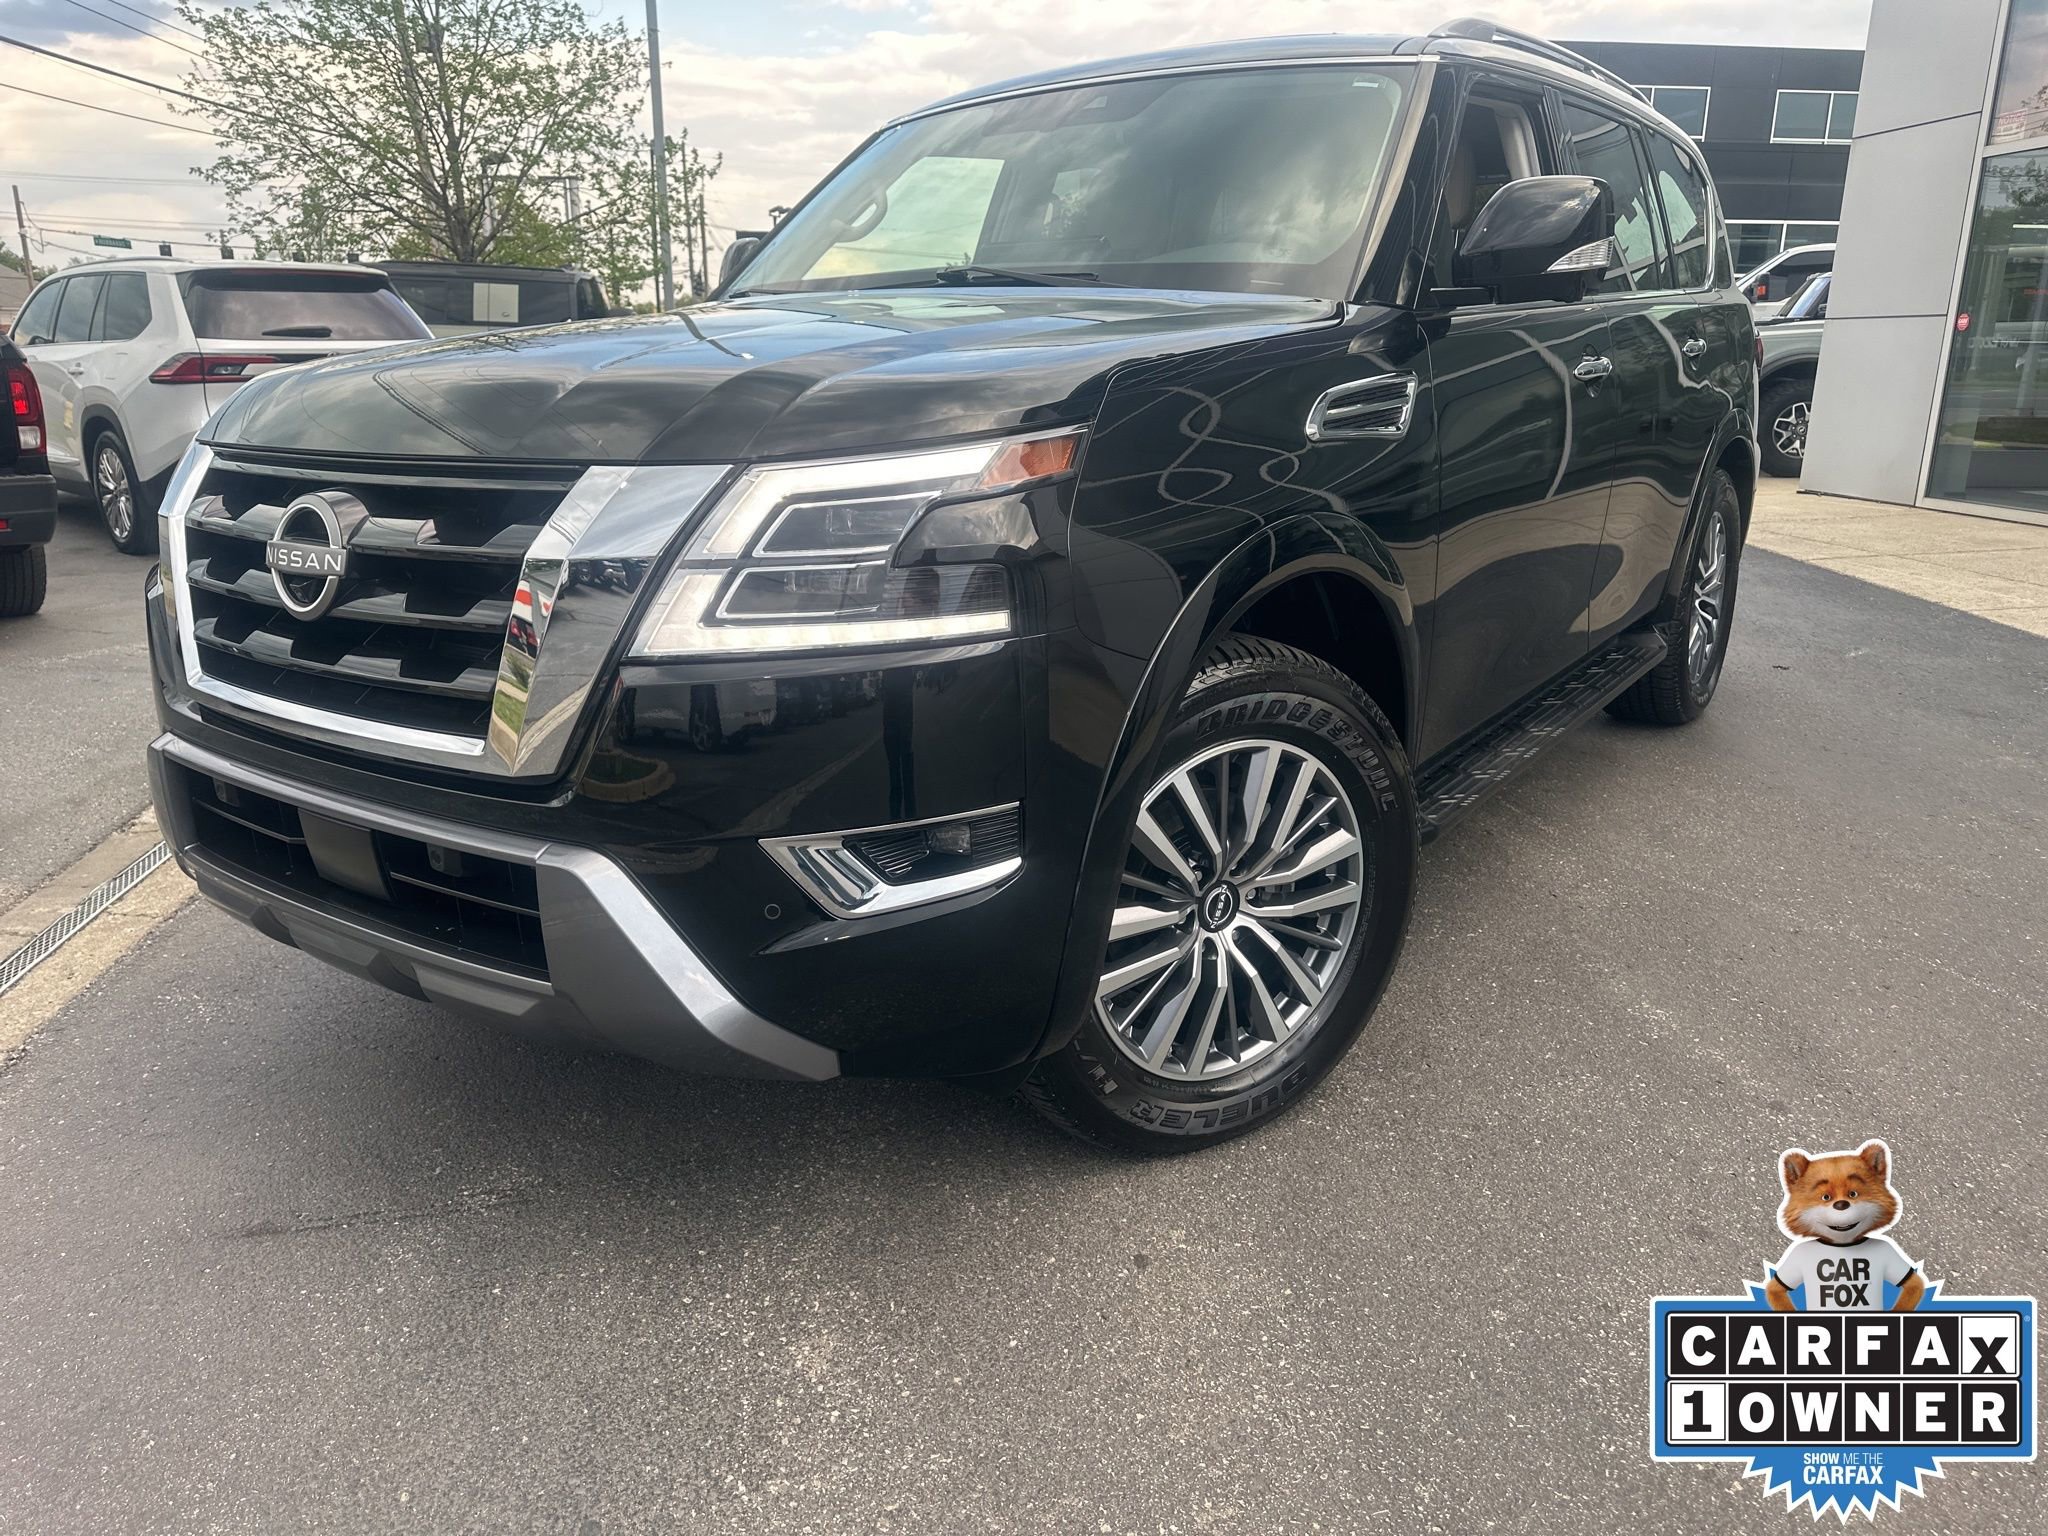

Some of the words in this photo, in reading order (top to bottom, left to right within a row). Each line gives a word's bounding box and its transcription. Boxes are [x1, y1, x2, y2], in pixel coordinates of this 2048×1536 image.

[267, 546, 341, 571] NISSAN
[1196, 699, 1398, 812] BRIDGESTONE
[1210, 884, 1227, 929] NISSAN
[1130, 1061, 1308, 1130] DUELER
